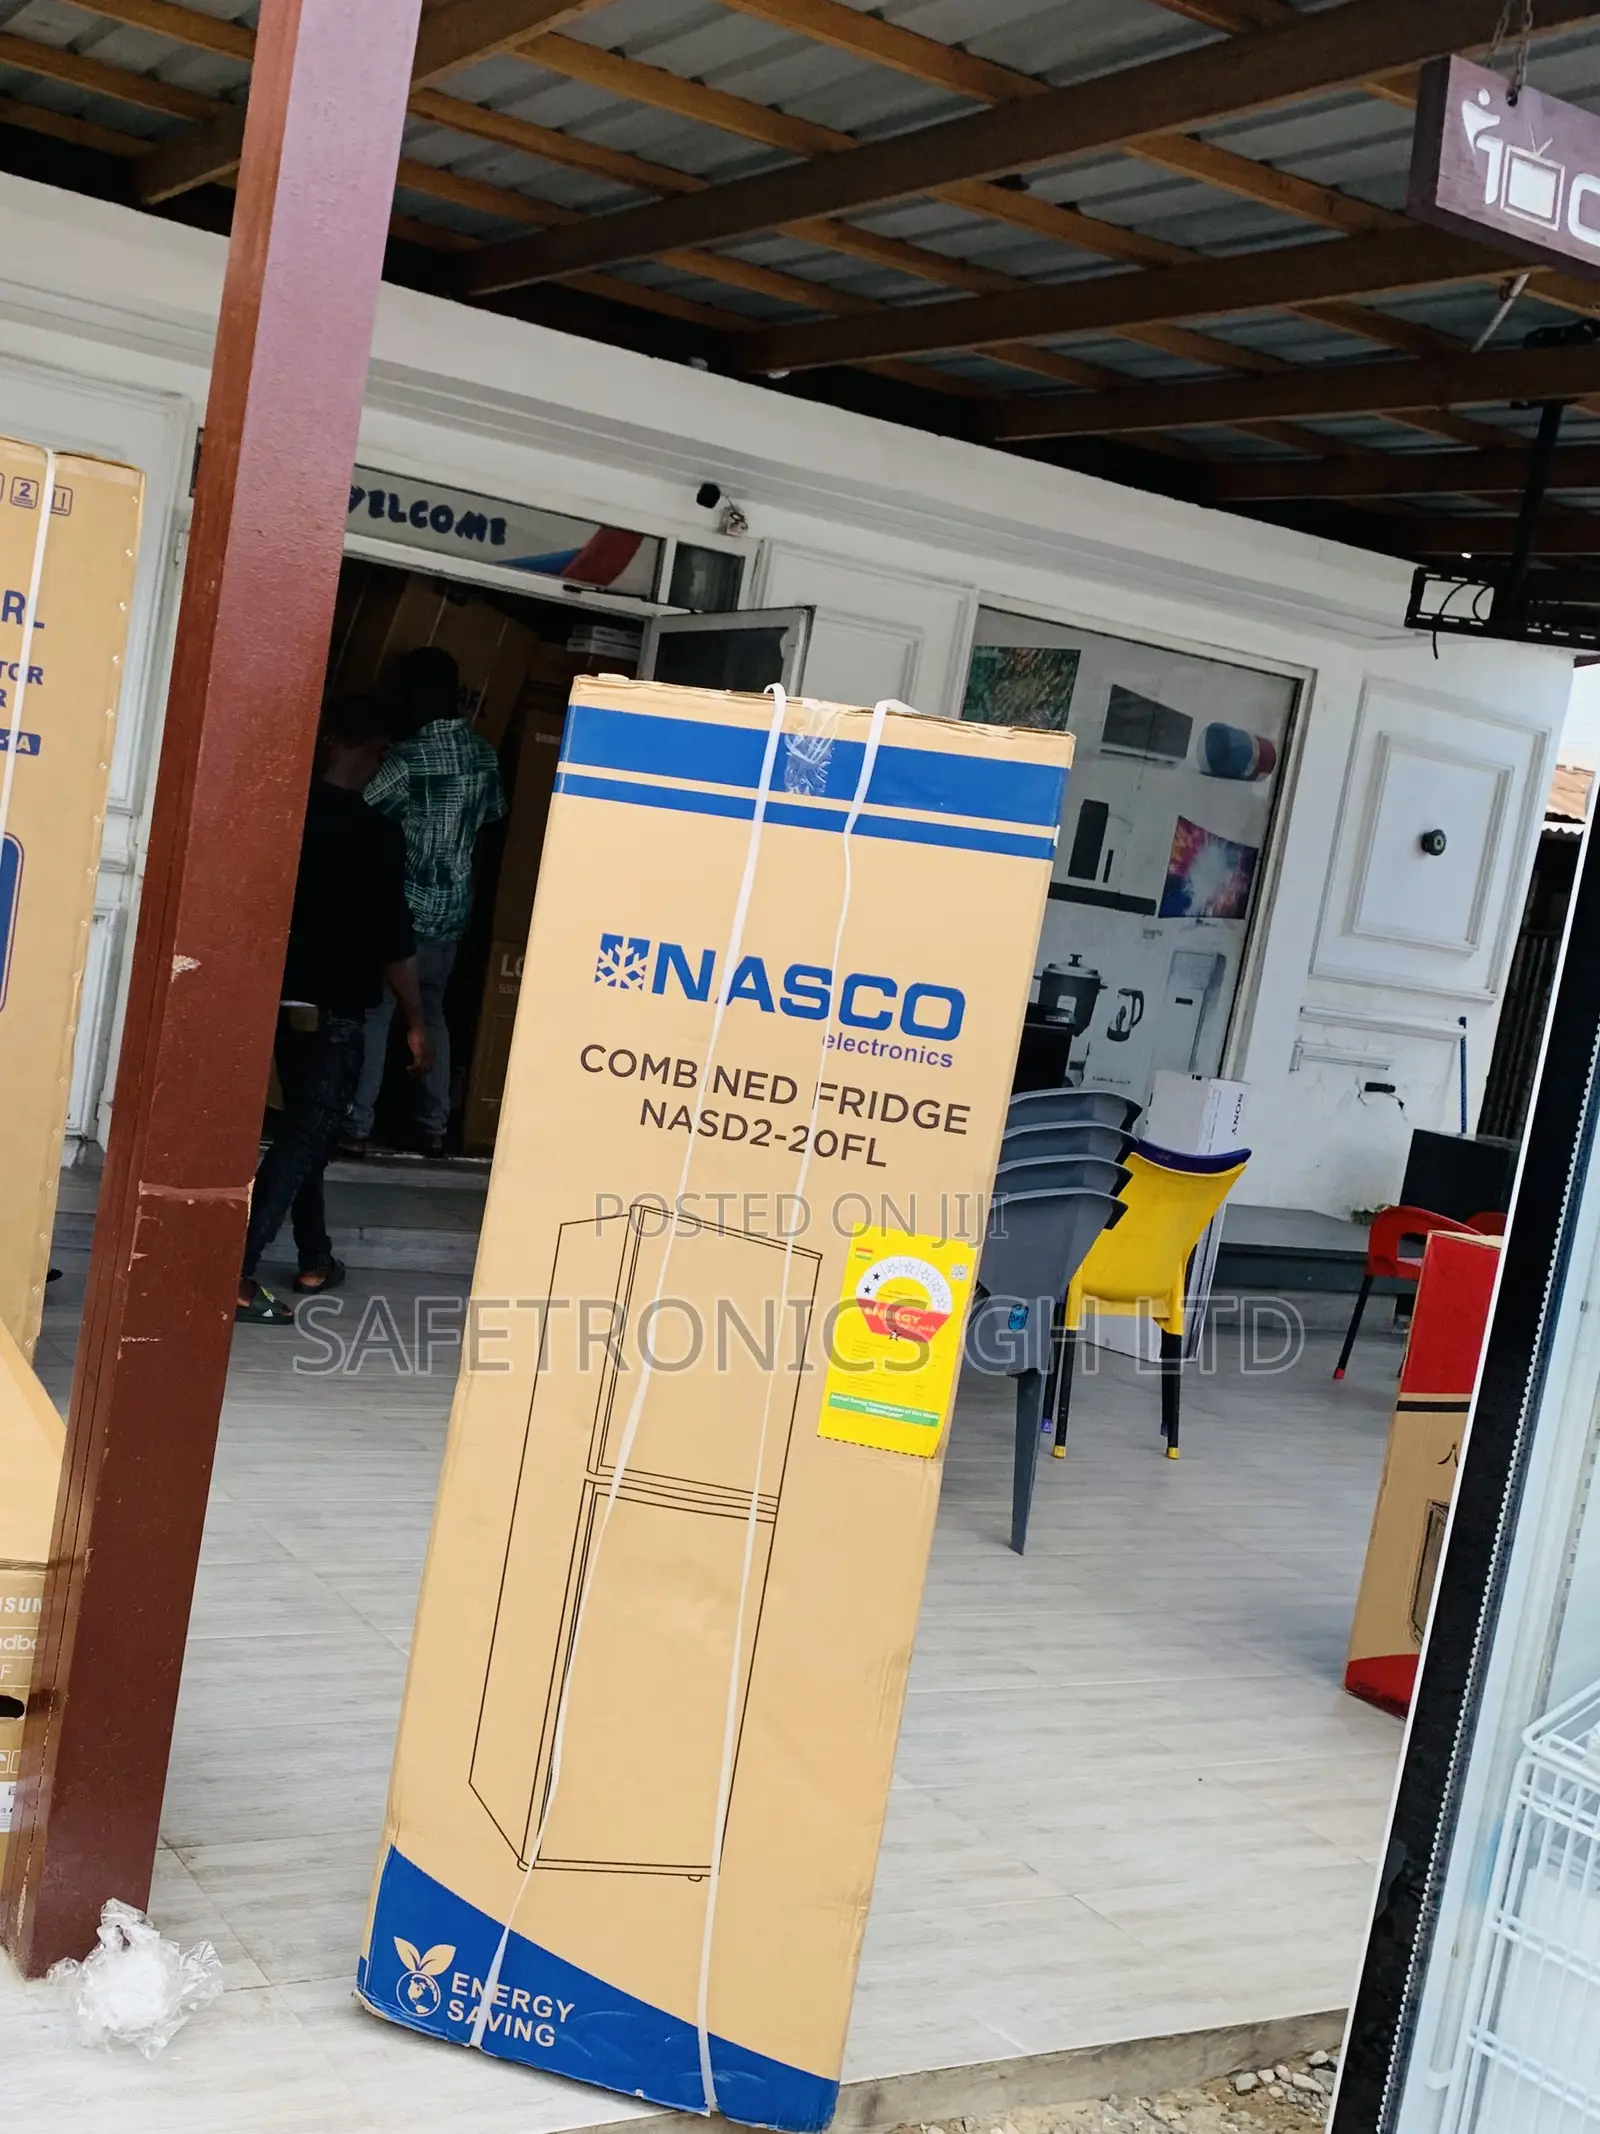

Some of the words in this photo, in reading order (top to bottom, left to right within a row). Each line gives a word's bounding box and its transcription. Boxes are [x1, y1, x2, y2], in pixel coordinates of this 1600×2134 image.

[651, 941, 967, 1042] NASCO
[823, 1031, 955, 1068] electronics
[580, 1043, 799, 1106] COMBNED
[812, 1080, 972, 1136] FRIDGE
[640, 1098, 888, 1168] NASD2-20FL
[446, 1998, 556, 2048] SAVING
[451, 1971, 576, 2024] ENERGY
